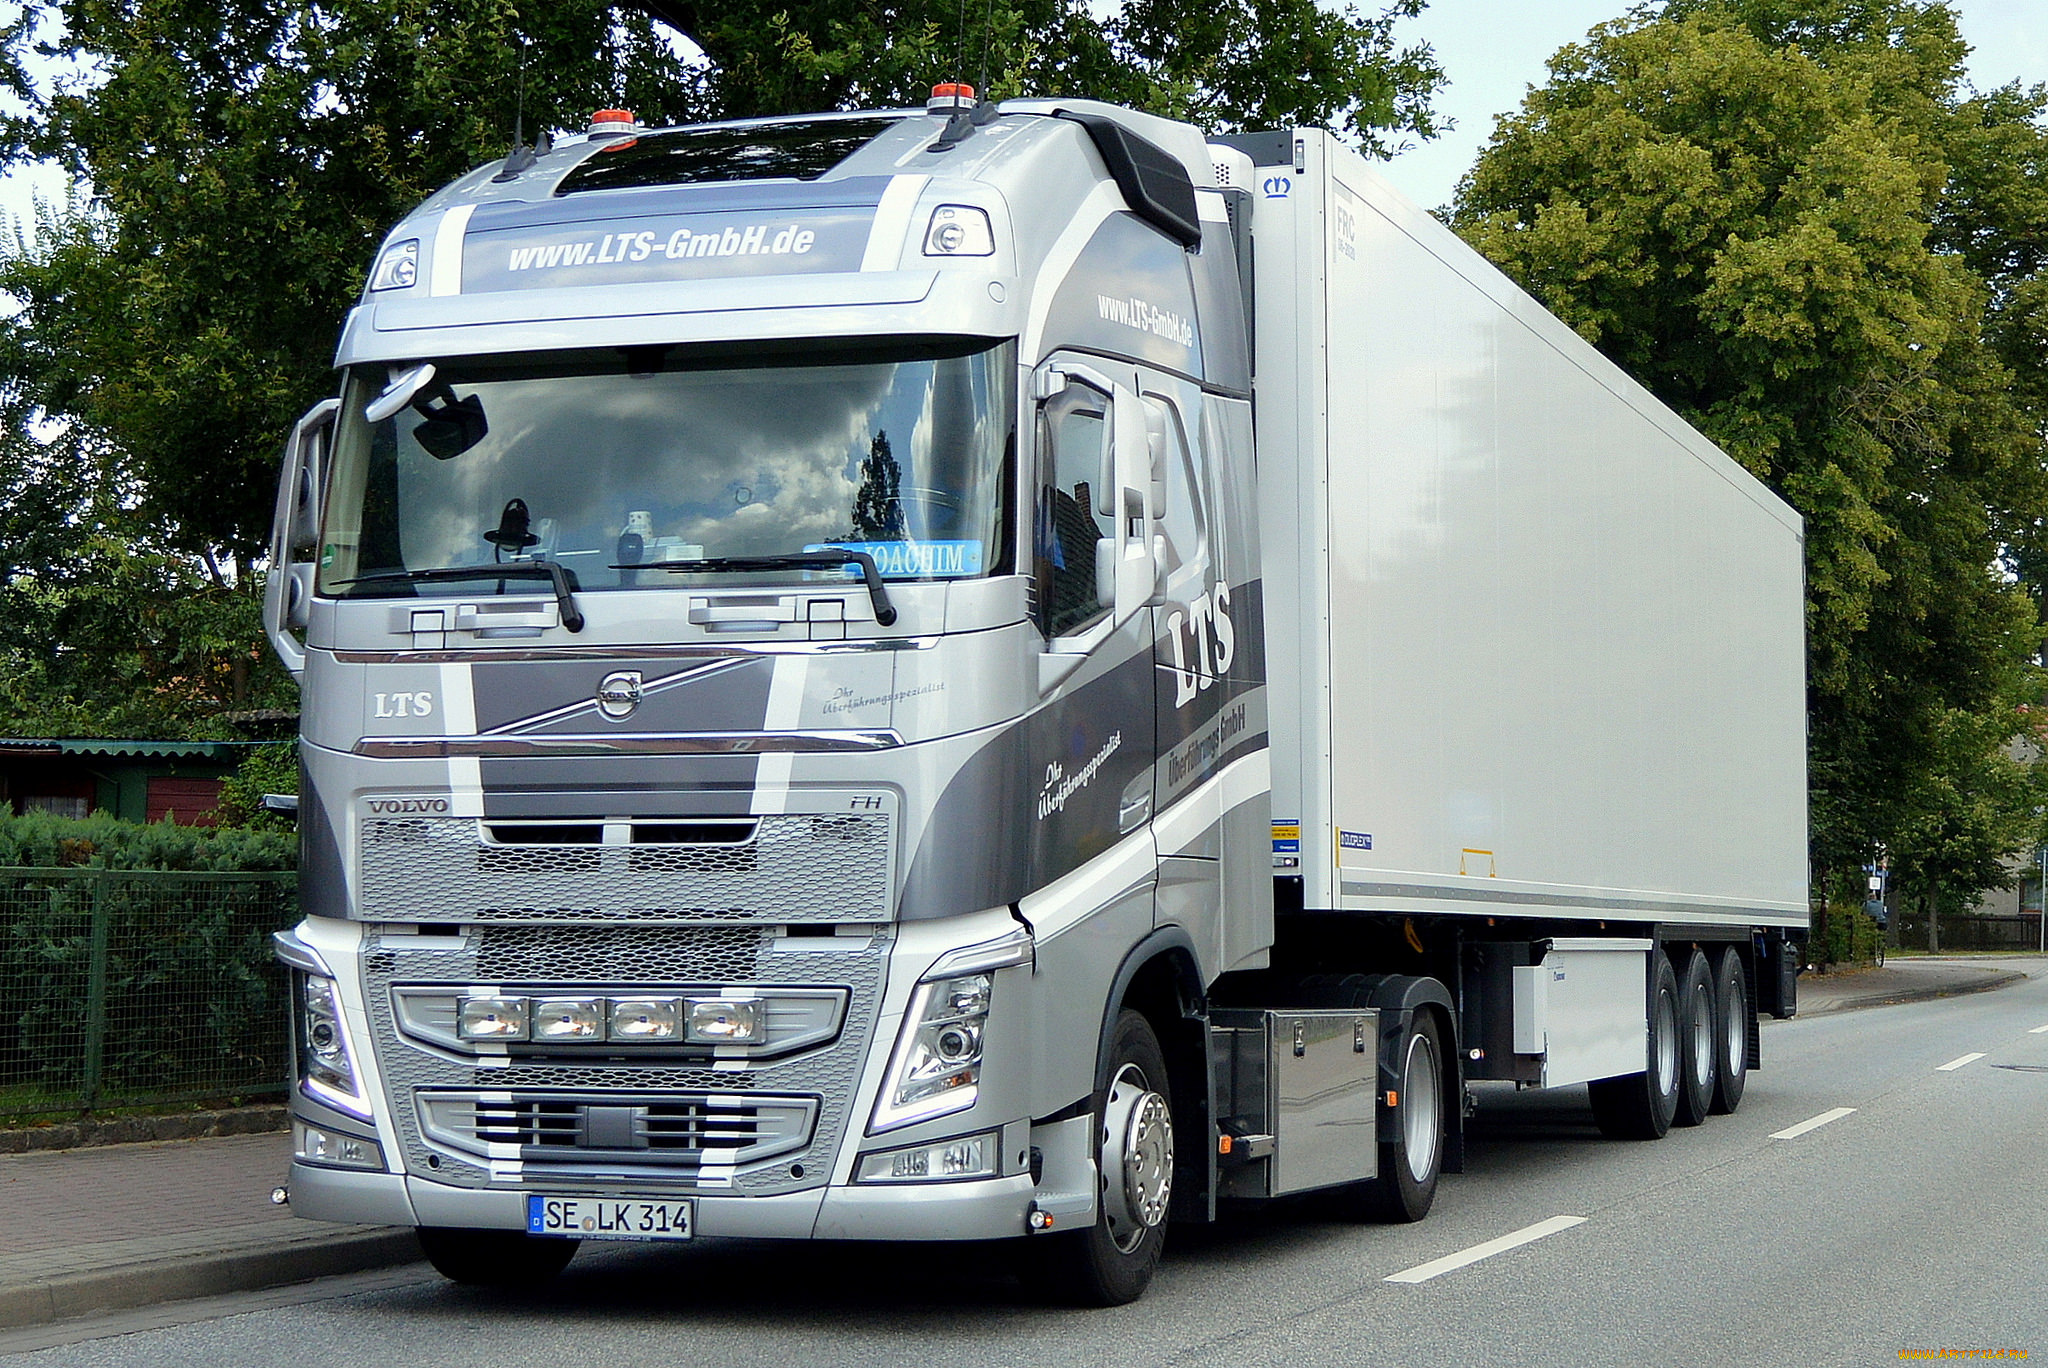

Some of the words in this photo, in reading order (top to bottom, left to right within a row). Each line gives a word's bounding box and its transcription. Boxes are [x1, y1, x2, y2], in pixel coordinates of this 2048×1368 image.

[1337, 206, 1355, 242] FRC
[508, 225, 815, 271] www.LTS-GmbH.de
[1097, 294, 1193, 348] www.LTS-GmbH.de
[865, 545, 966, 574] OACHIM
[1167, 580, 1235, 709] LTS
[374, 692, 433, 718] LTS
[1221, 703, 1246, 744] GmbH
[367, 799, 449, 813] VOLVO
[850, 796, 882, 809] FH
[546, 1201, 579, 1229] SE
[598, 1203, 632, 1231] LK
[639, 1204, 688, 1233] 314
